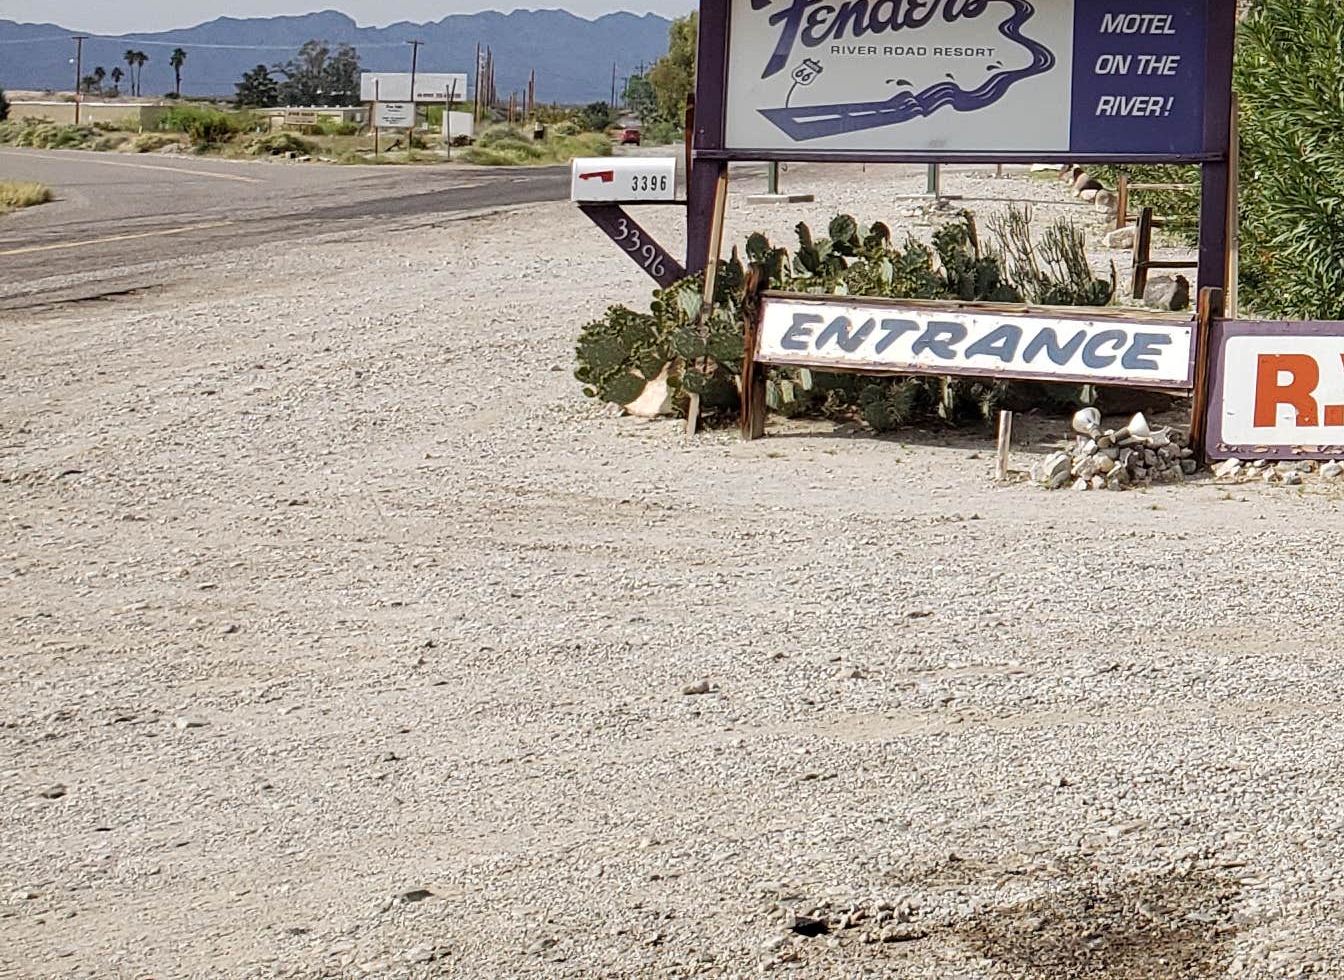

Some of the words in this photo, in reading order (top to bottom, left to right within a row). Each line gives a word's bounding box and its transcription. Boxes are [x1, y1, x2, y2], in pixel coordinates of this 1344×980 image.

[1099, 13, 1176, 35] MOTEL
[831, 45, 877, 56] RIVER
[884, 46, 928, 57] ROAD
[933, 47, 996, 58] RESORT
[1095, 54, 1132, 75] ON
[1137, 55, 1181, 75] THE
[1095, 95, 1175, 117] RIVER!
[632, 175, 667, 192] 3396
[613, 218, 665, 277] 3396
[779, 313, 1173, 371] ENTRANCE
